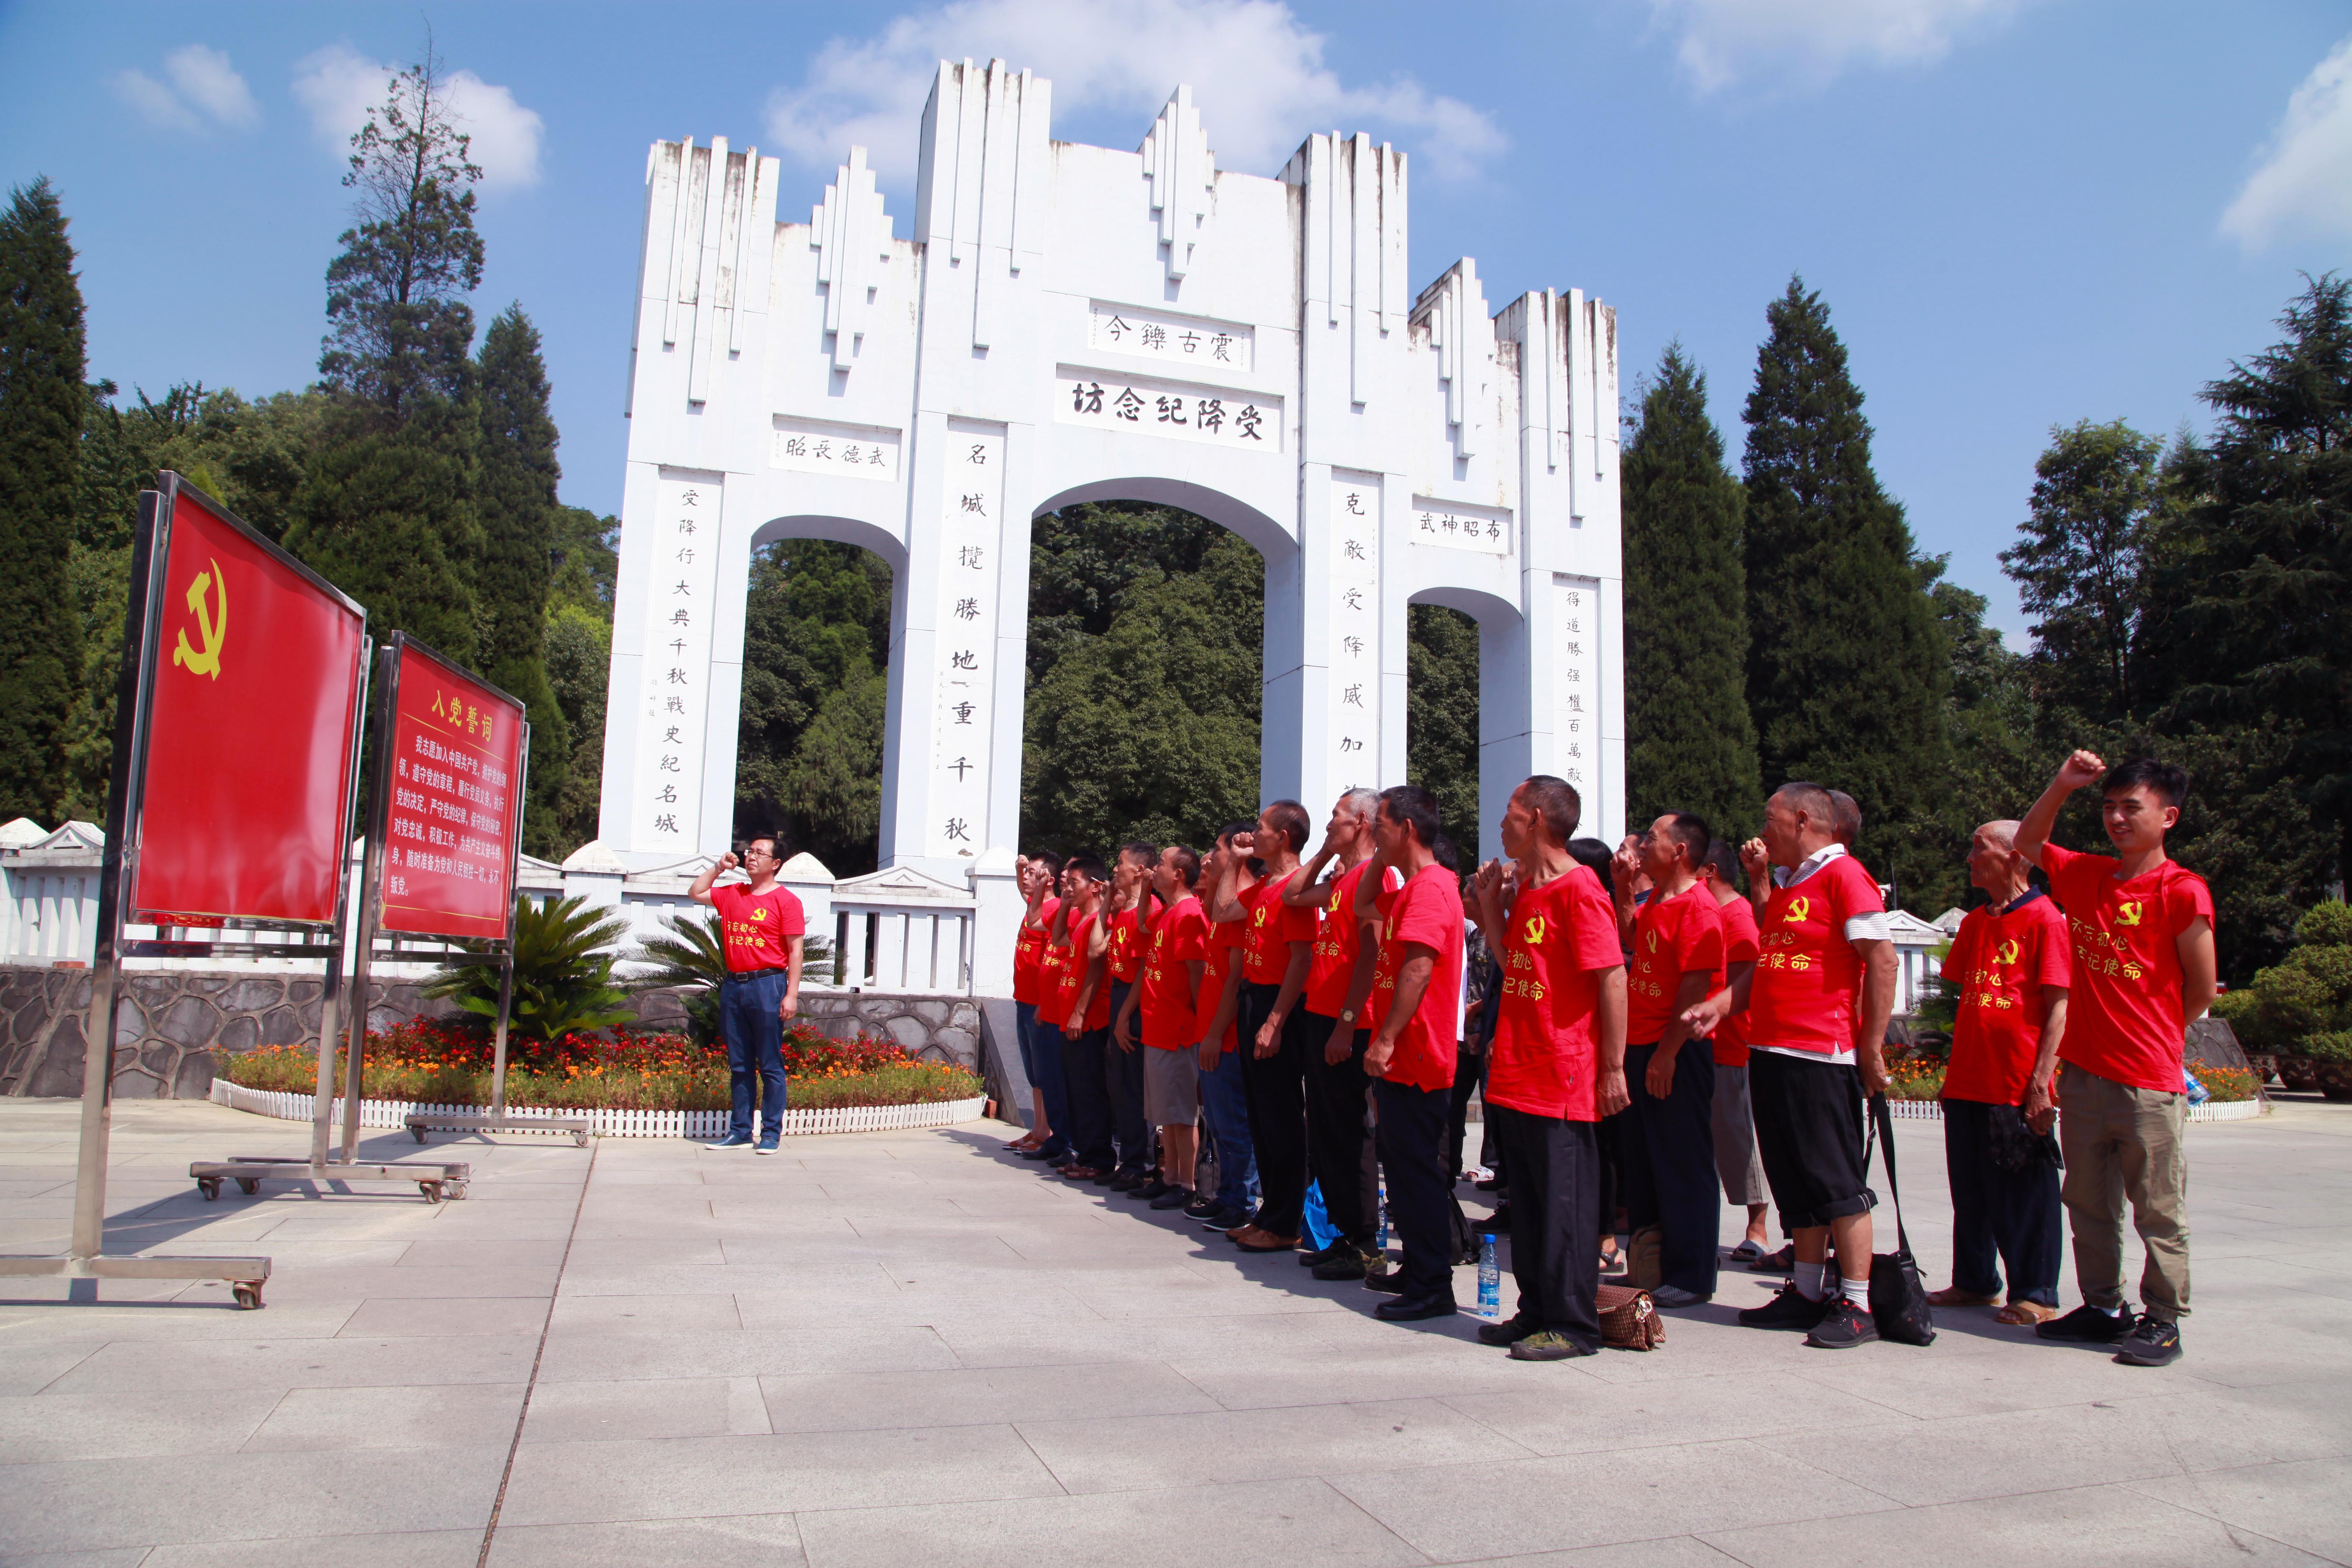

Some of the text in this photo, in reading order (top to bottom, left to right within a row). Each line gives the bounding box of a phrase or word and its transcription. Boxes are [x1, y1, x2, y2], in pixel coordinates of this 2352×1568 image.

[1339, 493, 1366, 789] 克敵受降威加
[432, 690, 492, 742] 入党誓词
[390, 875, 409, 896] 叛党。
[729, 935, 766, 948] 牢记使命
[2071, 917, 2128, 951] 不忘初心
[1756, 952, 1812, 971] 记使命
[2076, 945, 2144, 981] 牢记使命
[1502, 976, 1546, 1001] 记使命
